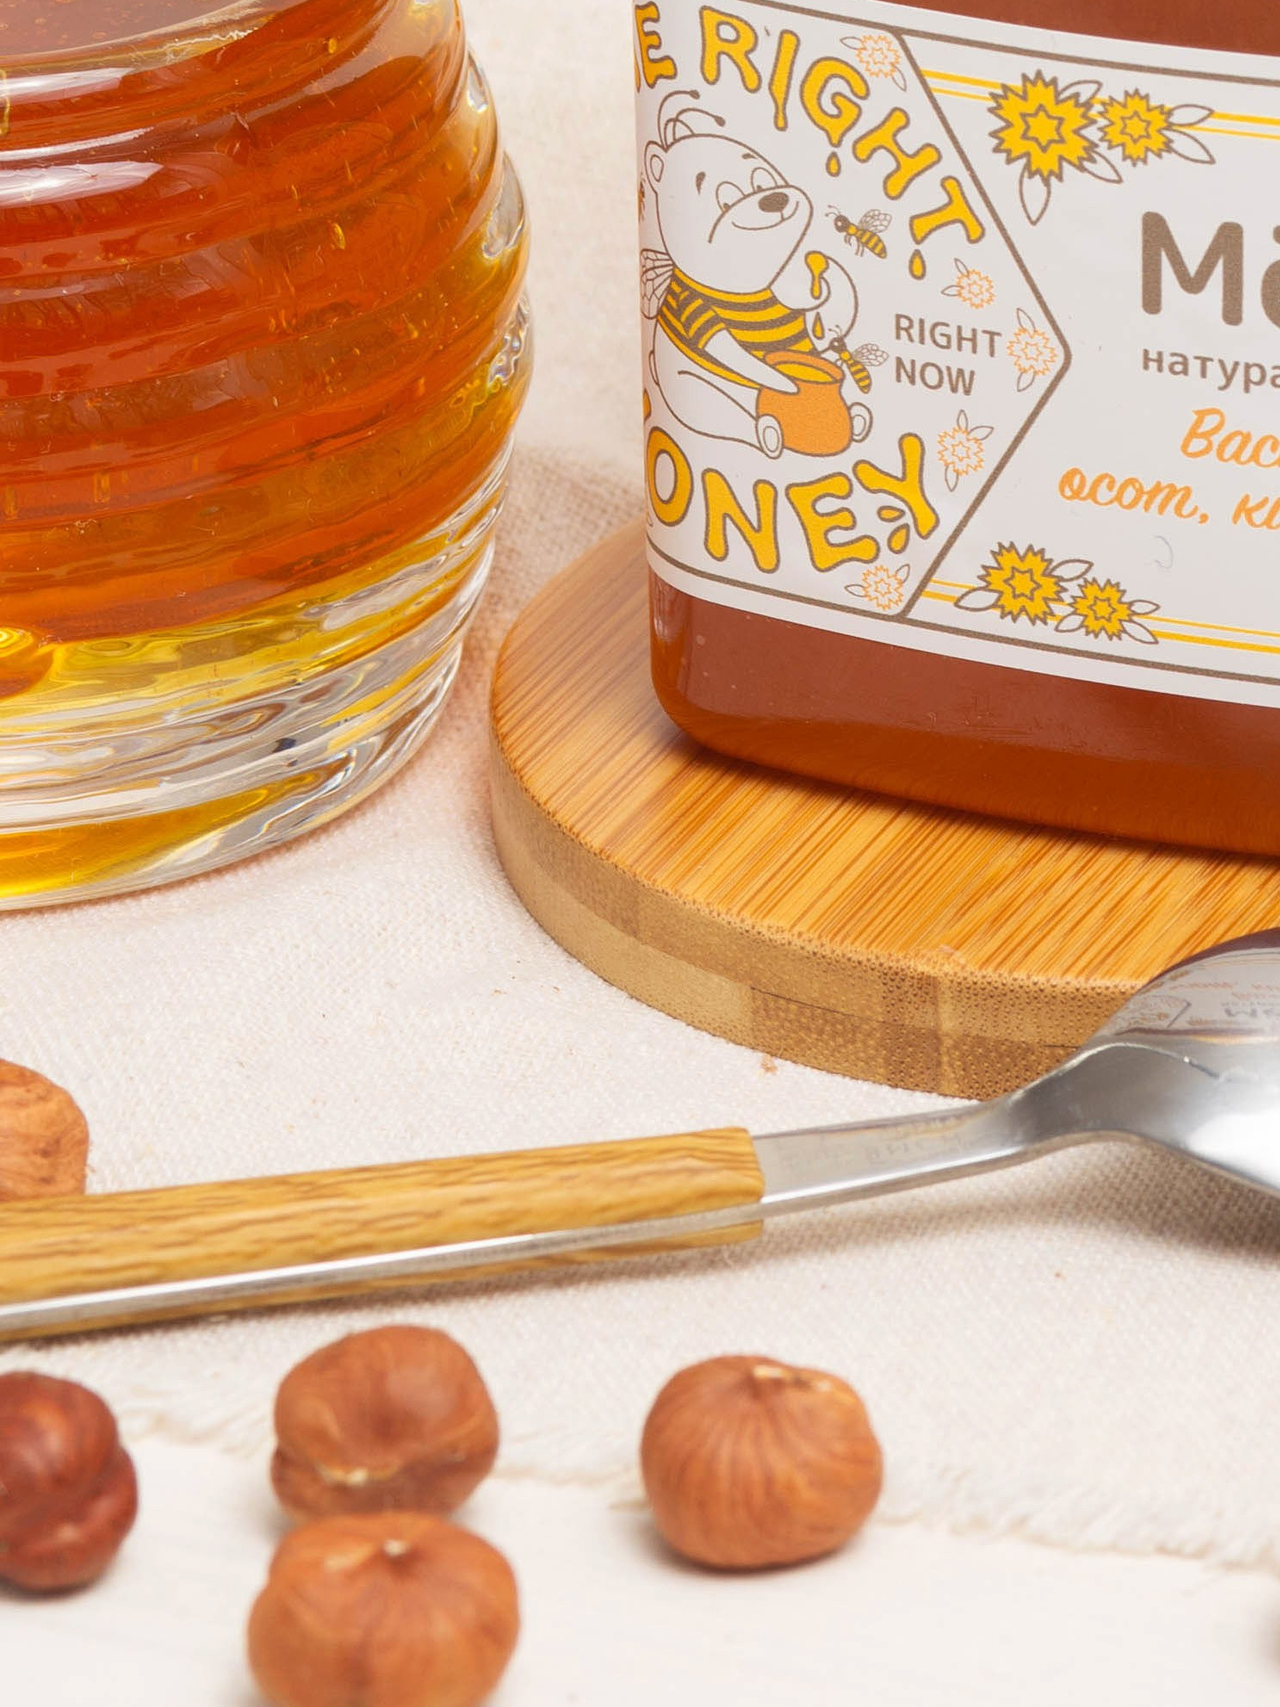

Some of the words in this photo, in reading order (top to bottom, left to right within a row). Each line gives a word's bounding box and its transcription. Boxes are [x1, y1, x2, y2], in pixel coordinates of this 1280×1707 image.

[698, 5, 985, 245] RIGHT
[894, 312, 1002, 359] RIGHT
[894, 355, 977, 398] NOW
[643, 388, 942, 574] ONEY
[1057, 465, 1210, 526] осот,
